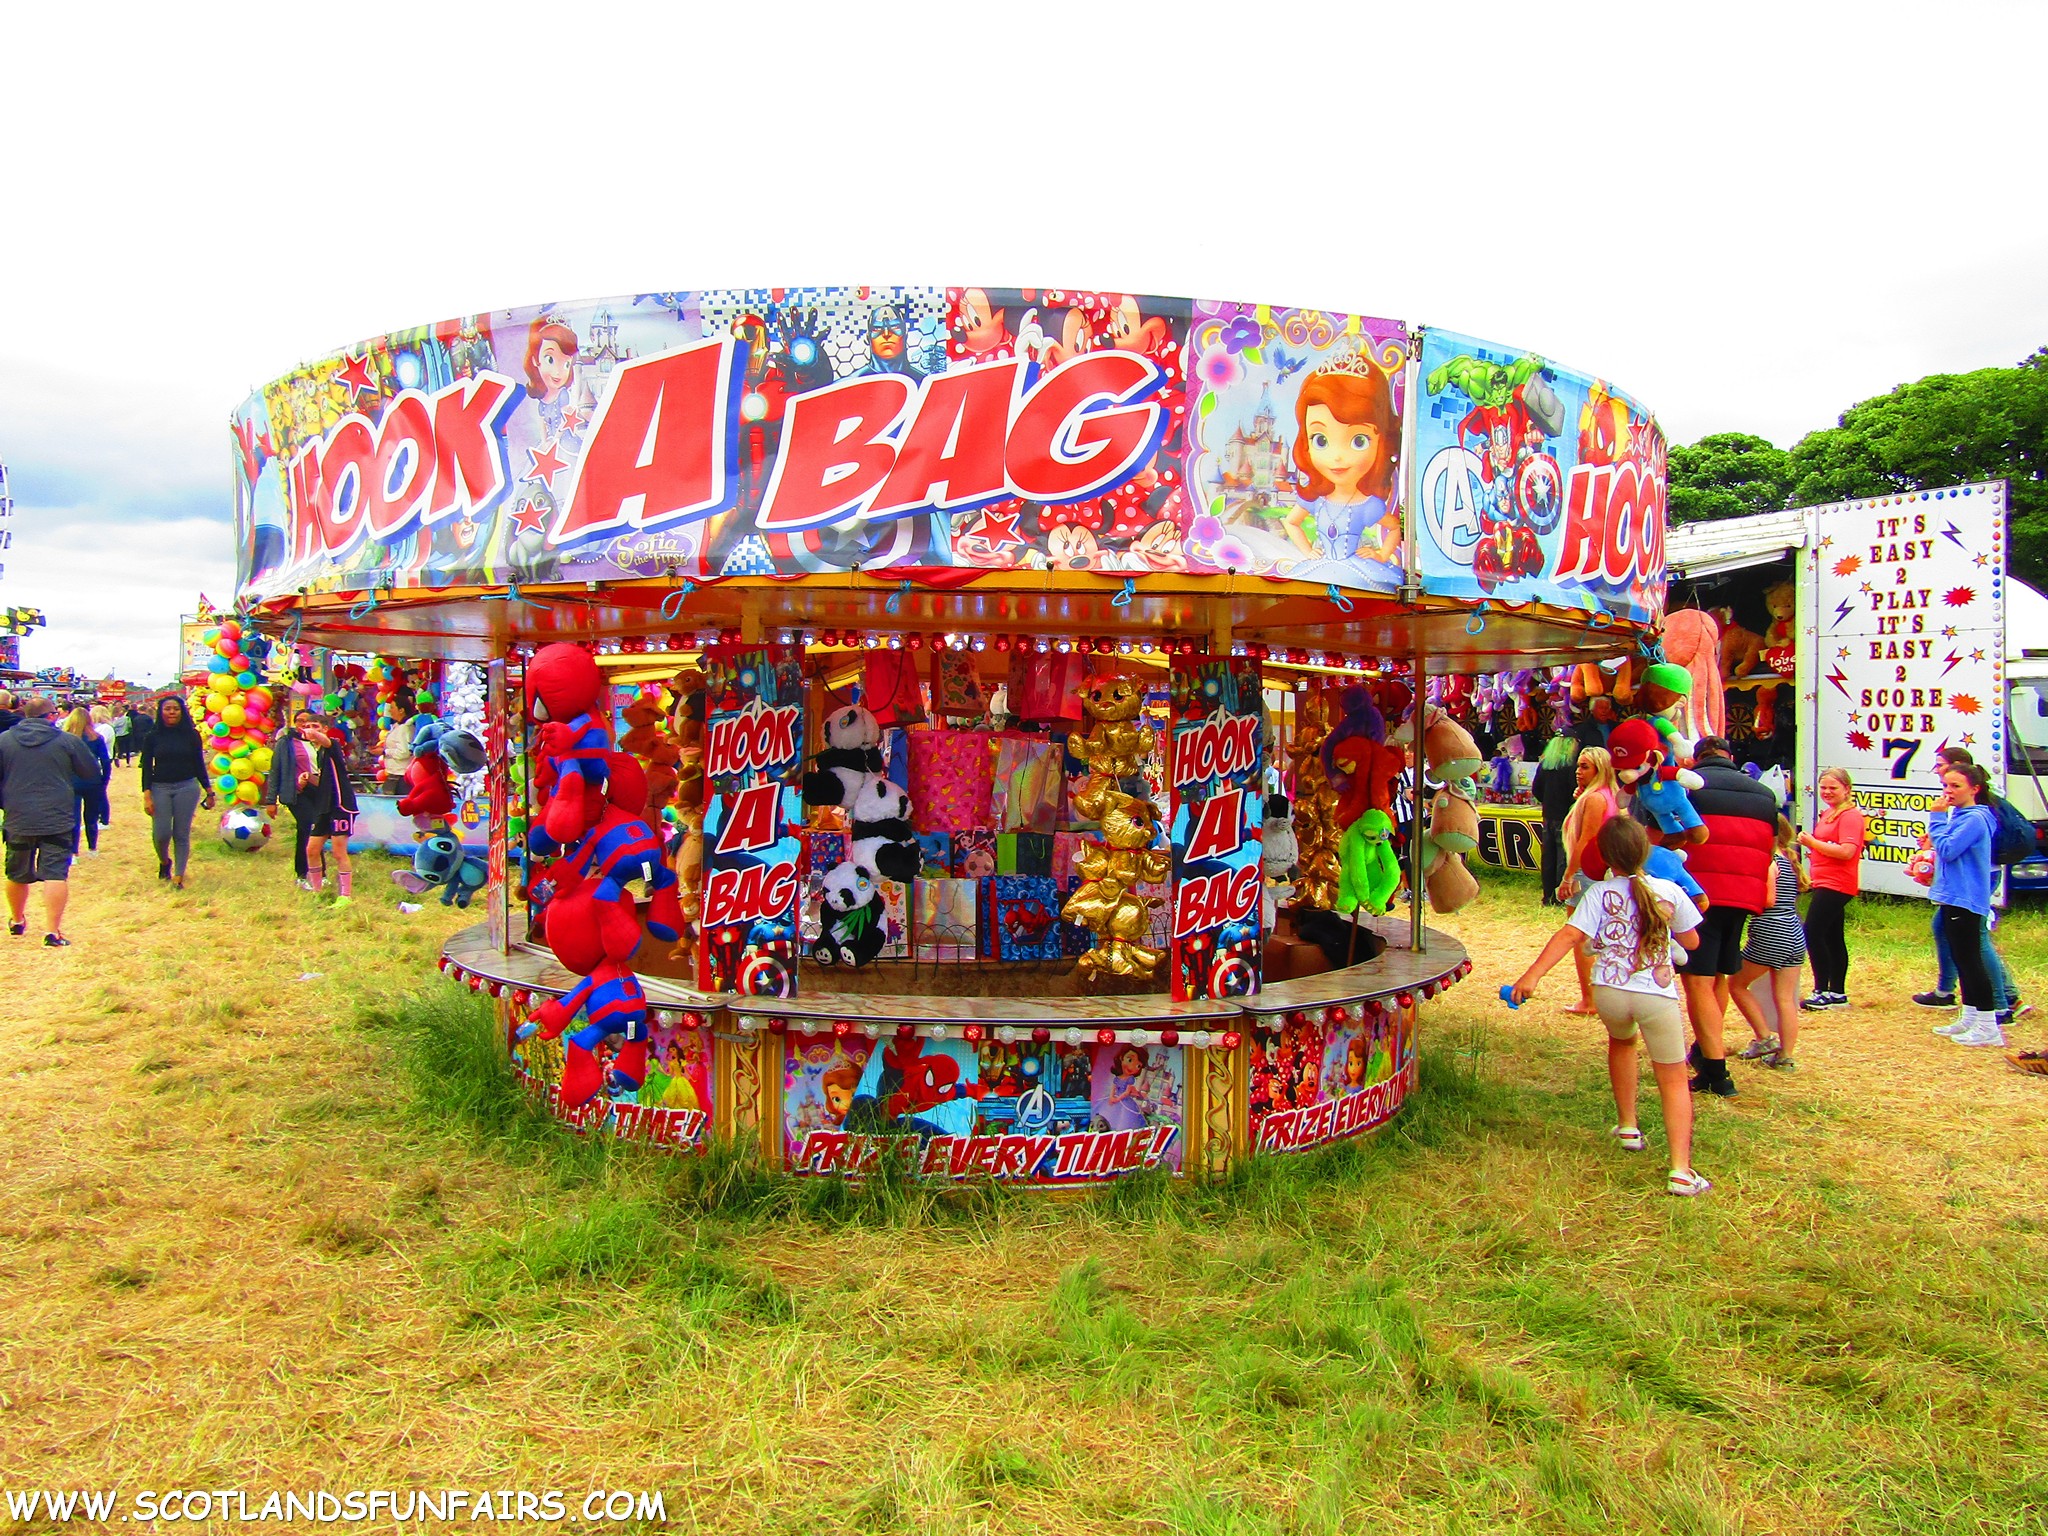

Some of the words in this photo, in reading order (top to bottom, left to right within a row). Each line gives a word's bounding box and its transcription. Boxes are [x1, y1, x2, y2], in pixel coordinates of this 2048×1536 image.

[288, 369, 517, 572] HOOK
[550, 336, 737, 545] A
[755, 349, 1166, 531] BAG
[1550, 460, 1666, 585] HOOK
[1876, 514, 1926, 539] IT'S
[617, 532, 678, 569] Sofia
[634, 553, 648, 566] the
[1869, 539, 1934, 564] EASY
[1896, 568, 1907, 585] 2
[1870, 588, 1932, 611] PLAY
[1877, 613, 1925, 635] IT'S
[1869, 639, 1934, 661] EASY
[1895, 665, 1907, 682] 2
[1861, 687, 1943, 708] SCORE
[1867, 713, 1936, 733] OVER
[708, 705, 799, 777] HOOK
[1173, 714, 1258, 788] HOOK
[1882, 738, 1922, 780] 7
[333, 819, 350, 832] 10
[715, 781, 782, 855] A
[1183, 788, 1245, 864] A
[1869, 818, 1925, 838] GETS
[702, 861, 798, 928] BAG
[1173, 864, 1261, 939] BAG
[1258, 1099, 1336, 1153] PRIZE
[1331, 1080, 1388, 1135] EVERY
[919, 1131, 1056, 1178] EVERY
[1051, 1124, 1179, 1177] TIME!
